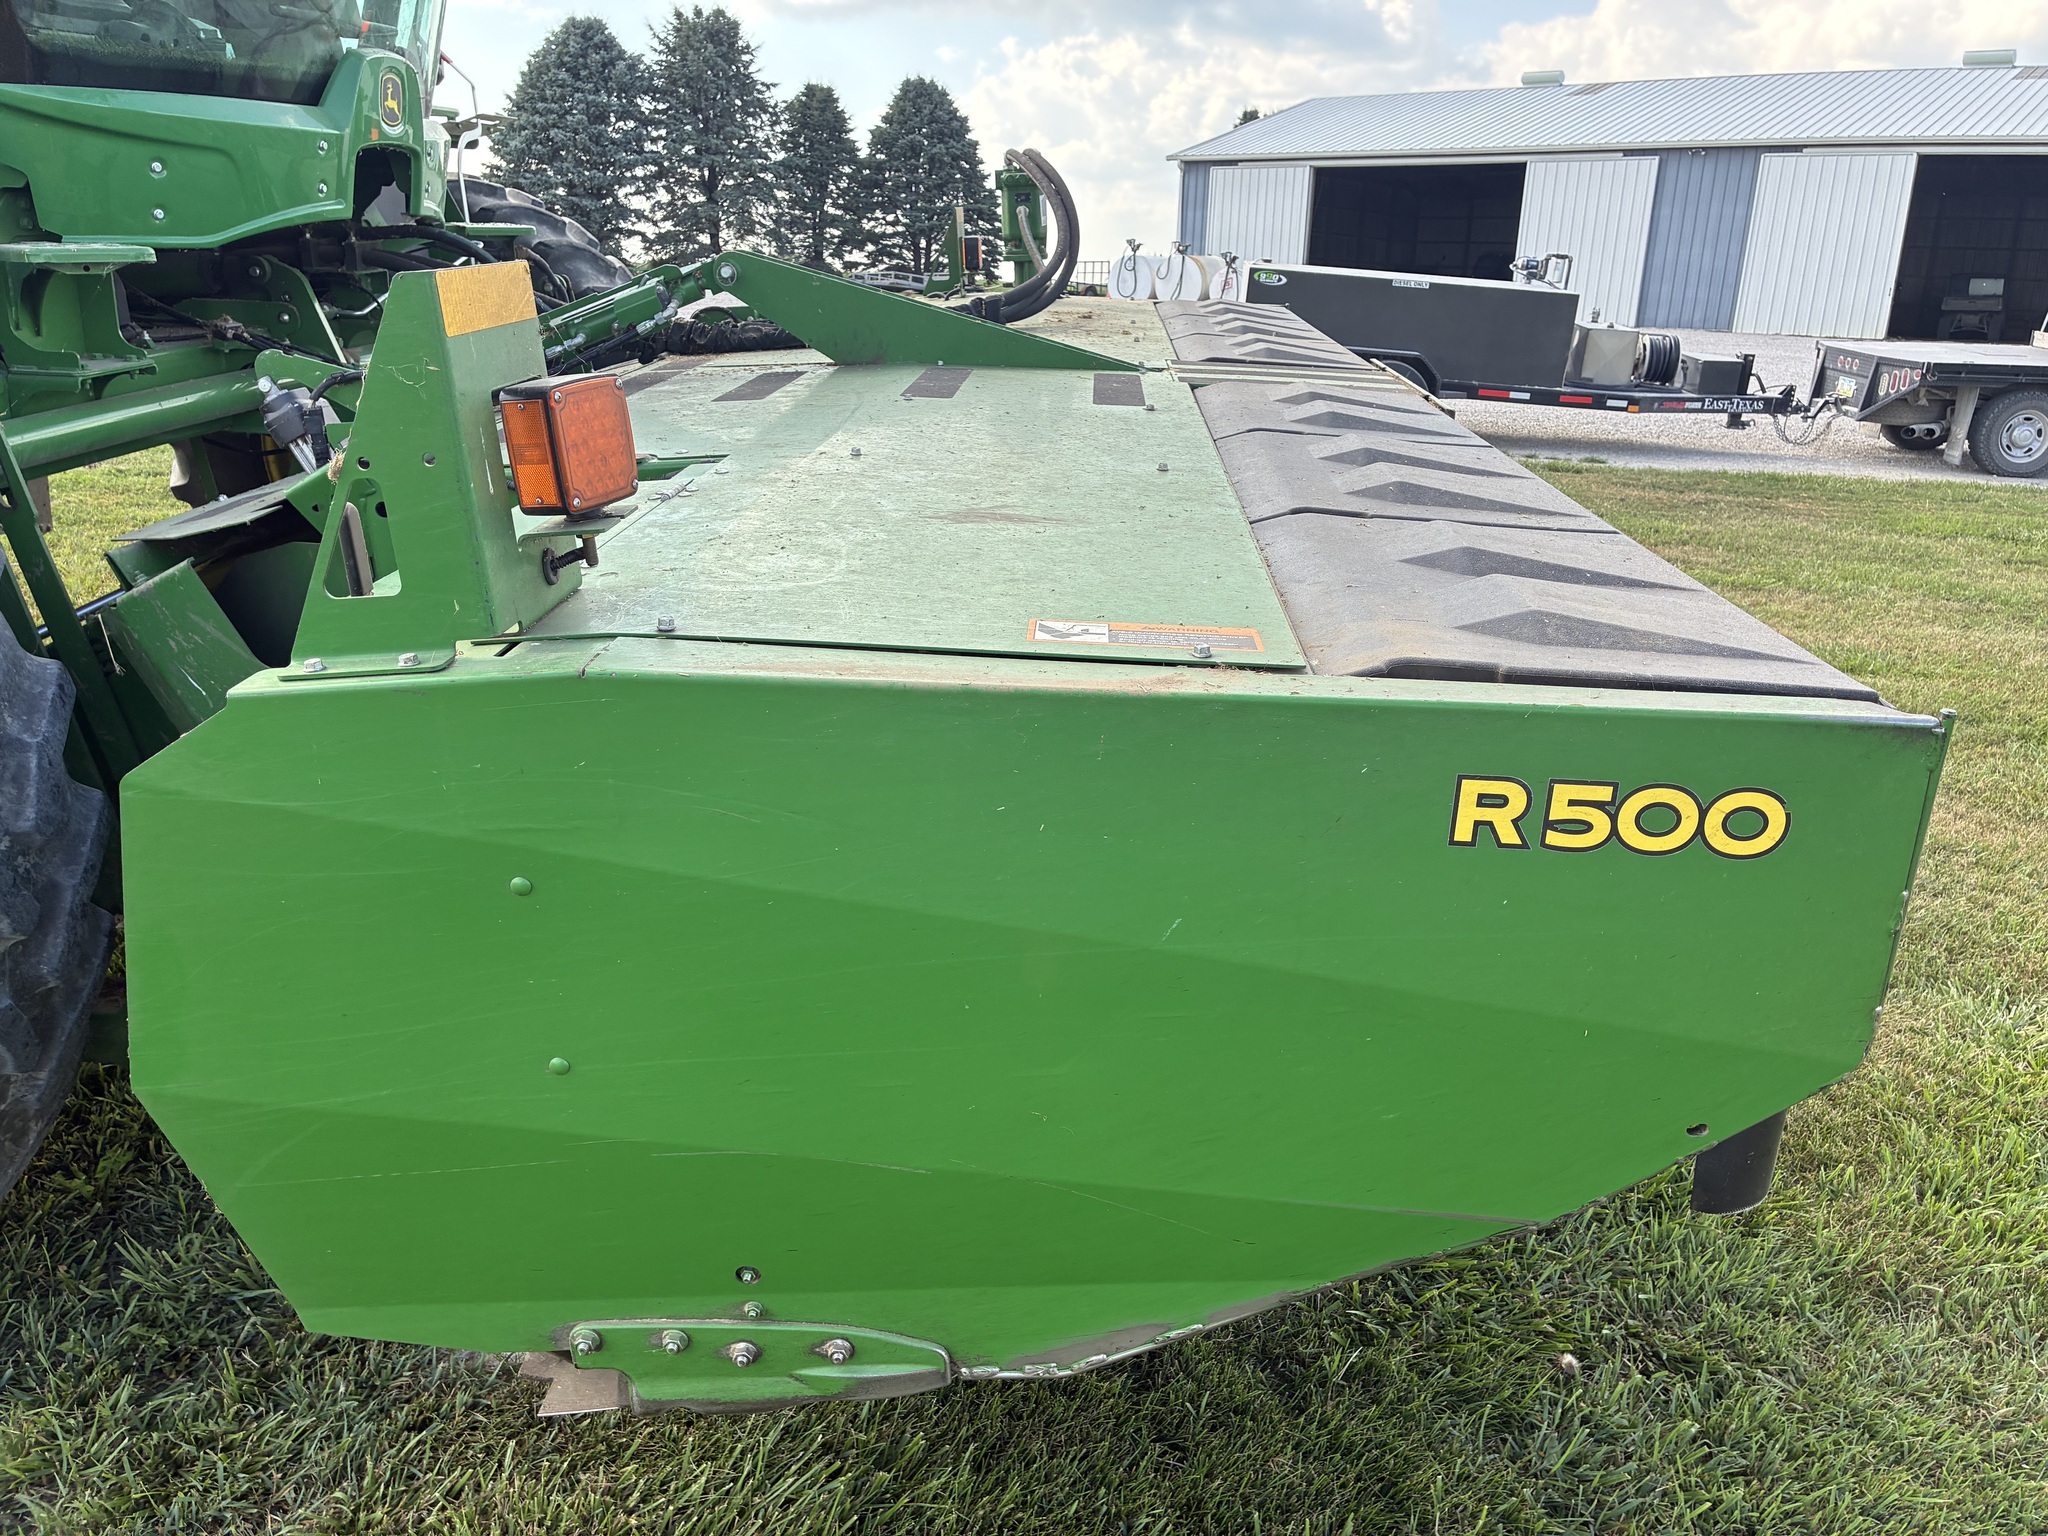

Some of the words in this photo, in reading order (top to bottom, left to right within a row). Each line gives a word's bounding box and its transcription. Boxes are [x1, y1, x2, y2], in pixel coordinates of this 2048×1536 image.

[1703, 398, 1731, 410] EAST
[1731, 398, 1765, 410] TEXAS
[1154, 626, 1220, 634] WARNING
